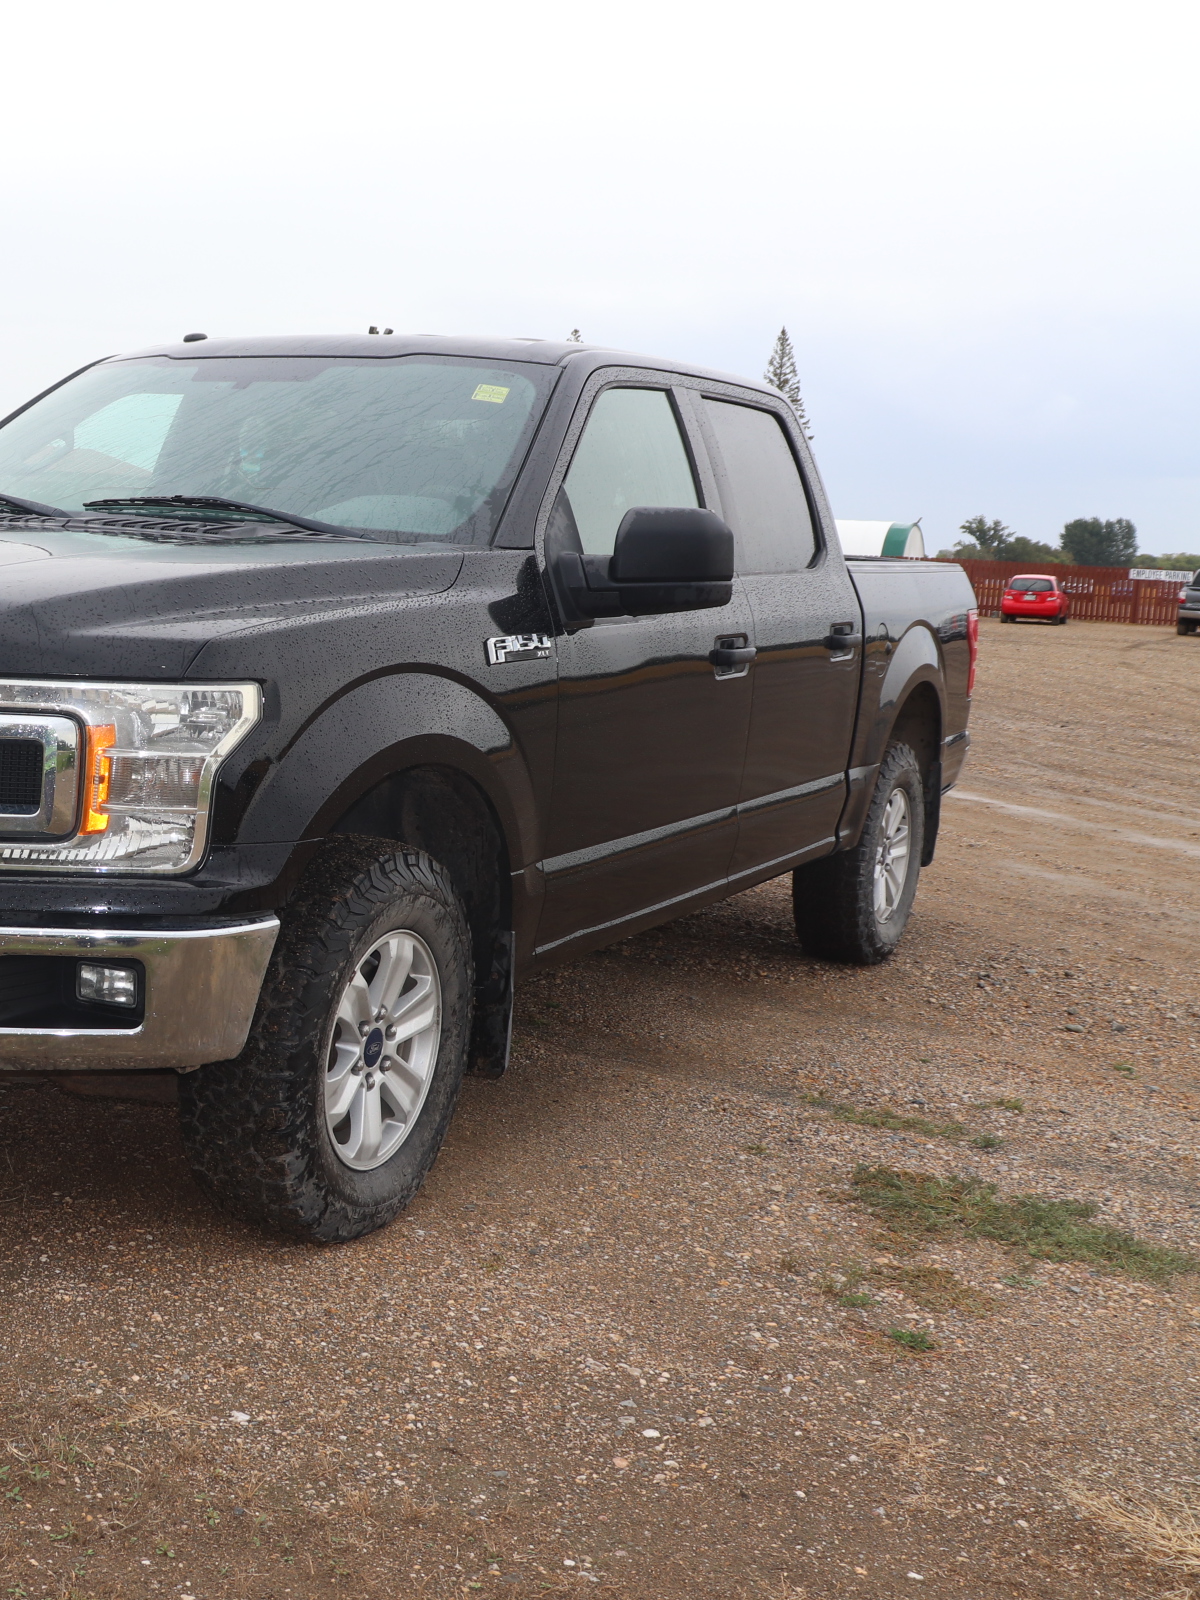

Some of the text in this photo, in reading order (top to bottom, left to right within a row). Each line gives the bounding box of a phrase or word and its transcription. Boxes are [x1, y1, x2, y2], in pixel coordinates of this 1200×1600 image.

[1132, 569, 1191, 581] EMPLOYEE PARKING
[537, 649, 550, 657] XLT
